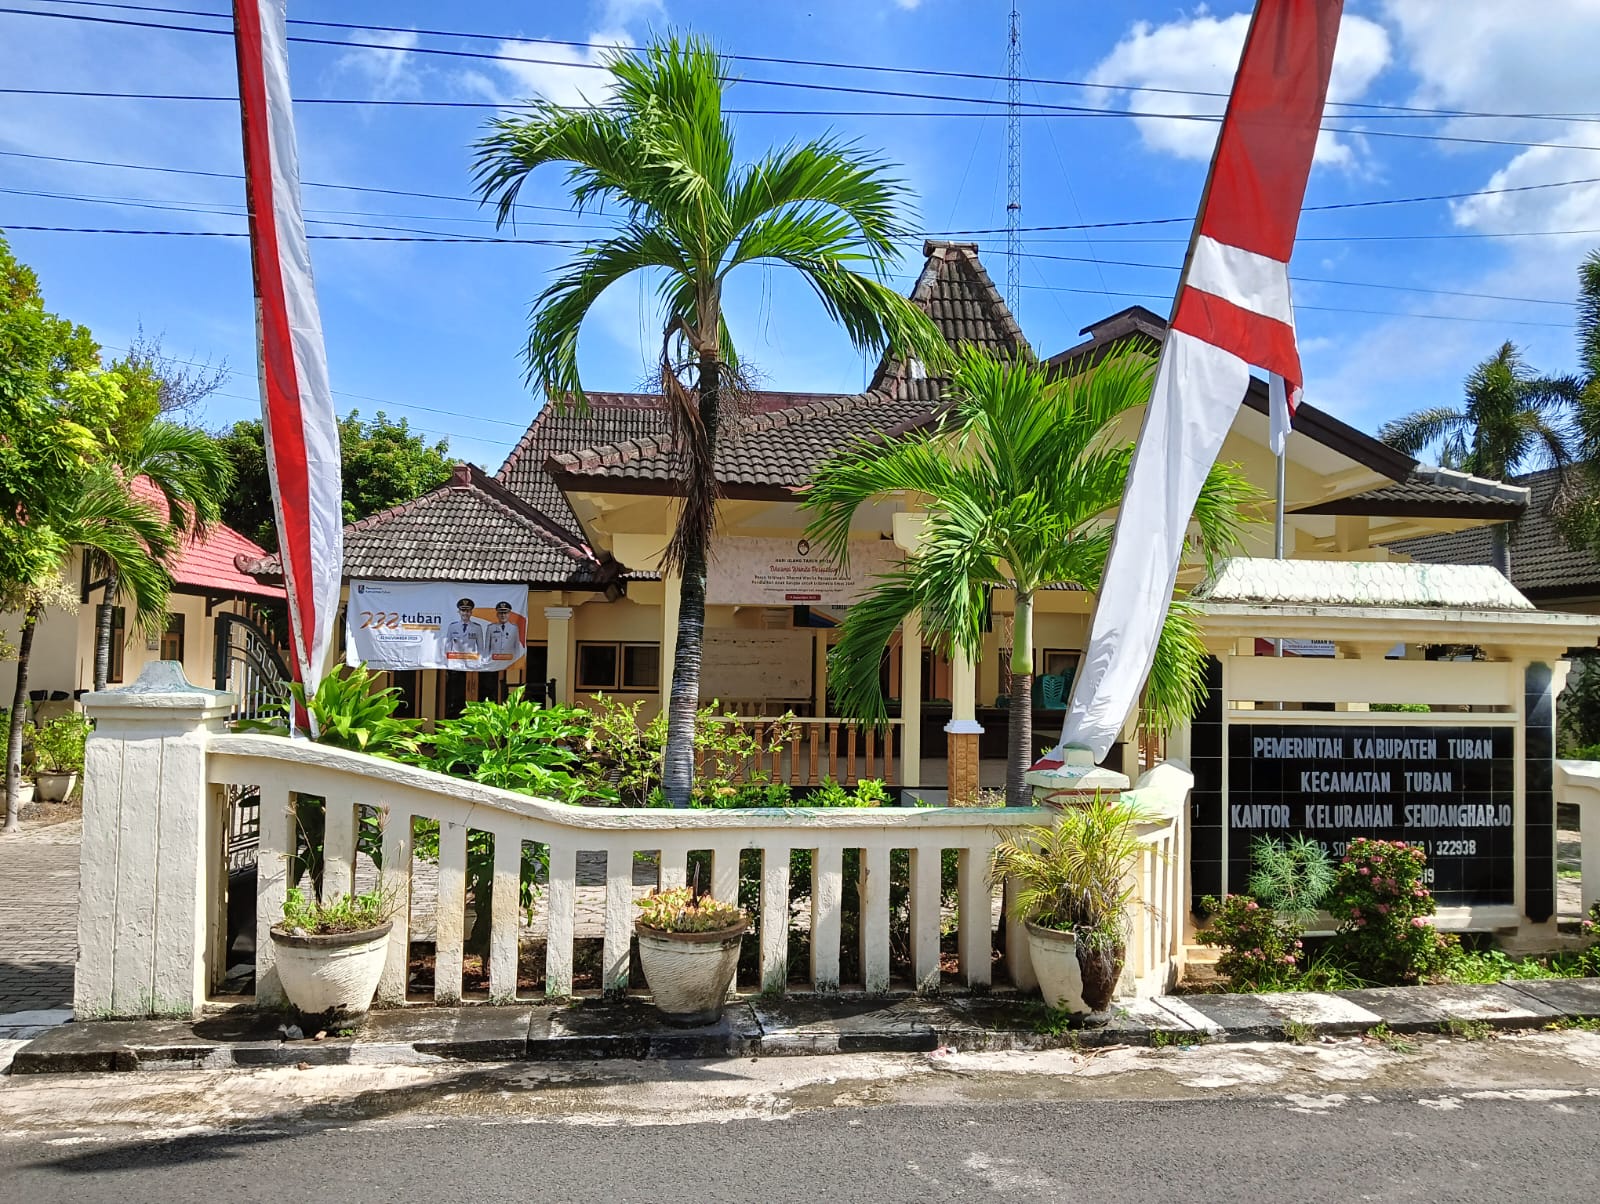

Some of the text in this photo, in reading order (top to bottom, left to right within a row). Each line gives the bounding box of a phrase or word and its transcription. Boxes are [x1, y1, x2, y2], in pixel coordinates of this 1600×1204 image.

[402, 612, 442, 624] tuban
[1254, 737, 1493, 760] PEMERINTAH KABUPATEN TUBAN
[1301, 772, 1452, 793] KECAMATAN TUBAN
[1231, 804, 1511, 828] KANTOR KELURAHAN SENDANGHARJO
[1436, 840, 1477, 856] 322938
